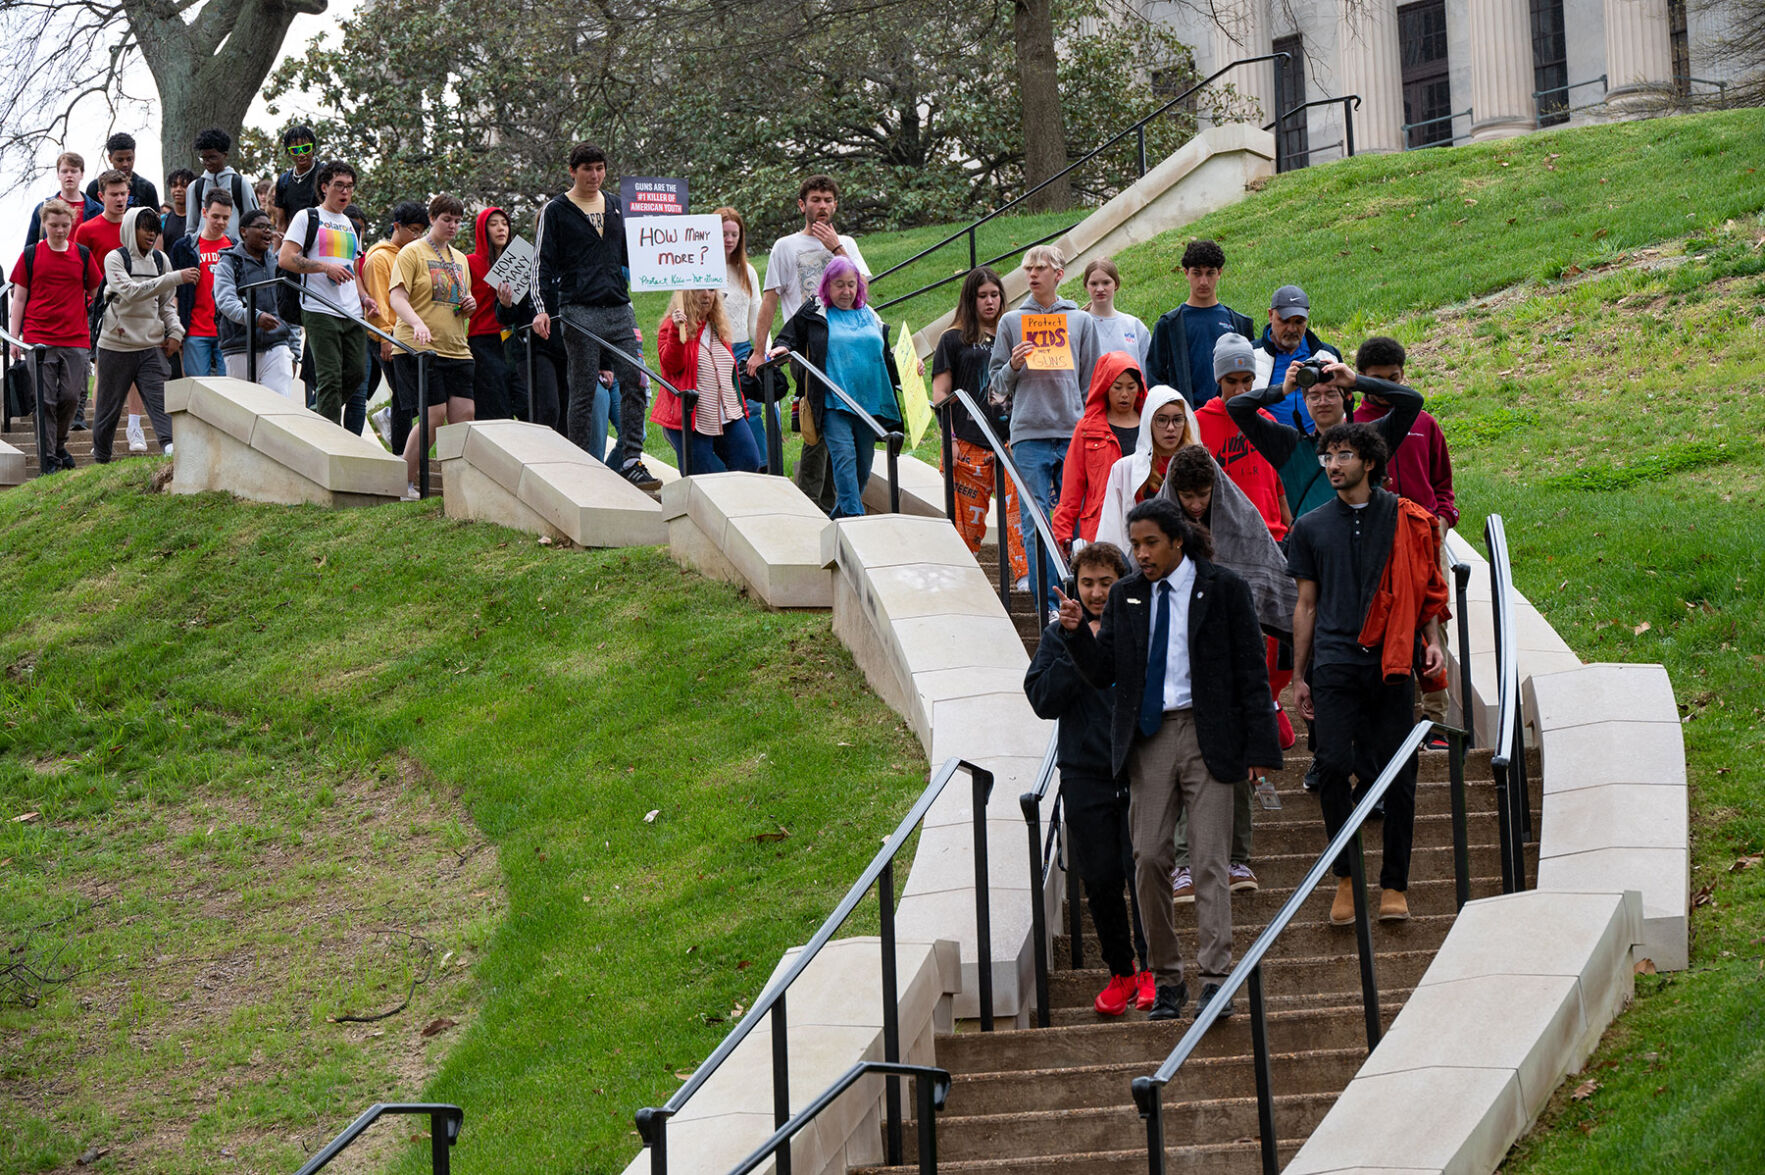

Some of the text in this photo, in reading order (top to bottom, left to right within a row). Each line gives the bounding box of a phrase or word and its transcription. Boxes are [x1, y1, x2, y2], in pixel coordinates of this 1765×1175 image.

[635, 182, 677, 192] GUNS ARE THE
[637, 193, 677, 202] #1 KILLER OF
[630, 203, 682, 213] AMERICAN YOUTH
[640, 227, 711, 247] HOW MANY
[199, 252, 221, 264] VID
[492, 250, 517, 278] HOW
[513, 267, 531, 296] MOR
[1028, 317, 1062, 327] Protect
[1026, 328, 1066, 348] KIDS
[1032, 354, 1068, 367] GUNS
